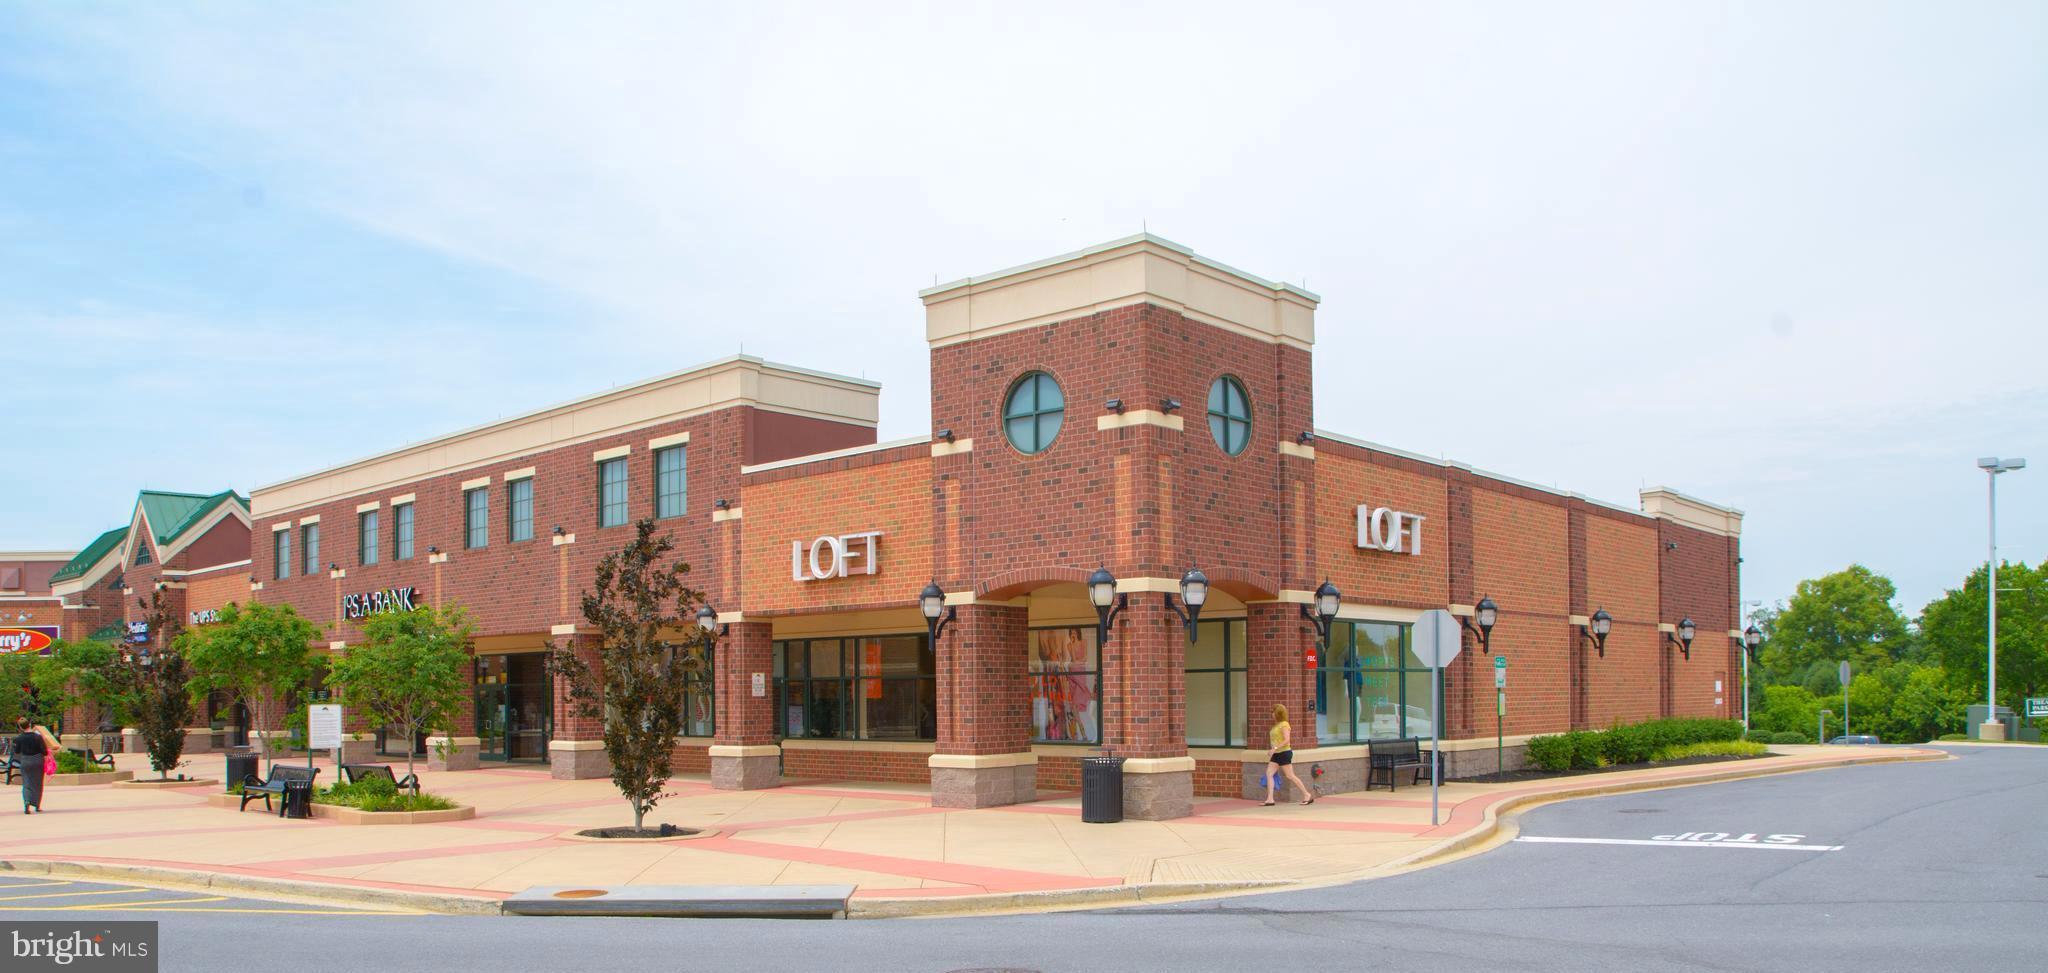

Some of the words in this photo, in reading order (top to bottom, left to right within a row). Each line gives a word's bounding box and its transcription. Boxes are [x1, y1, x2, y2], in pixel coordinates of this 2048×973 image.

[1357, 504, 1427, 555] LOFT
[792, 531, 884, 581] LOFT
[374, 586, 416, 615] BANK
[200, 609, 211, 624] UPS
[1651, 832, 1807, 844] STOP
